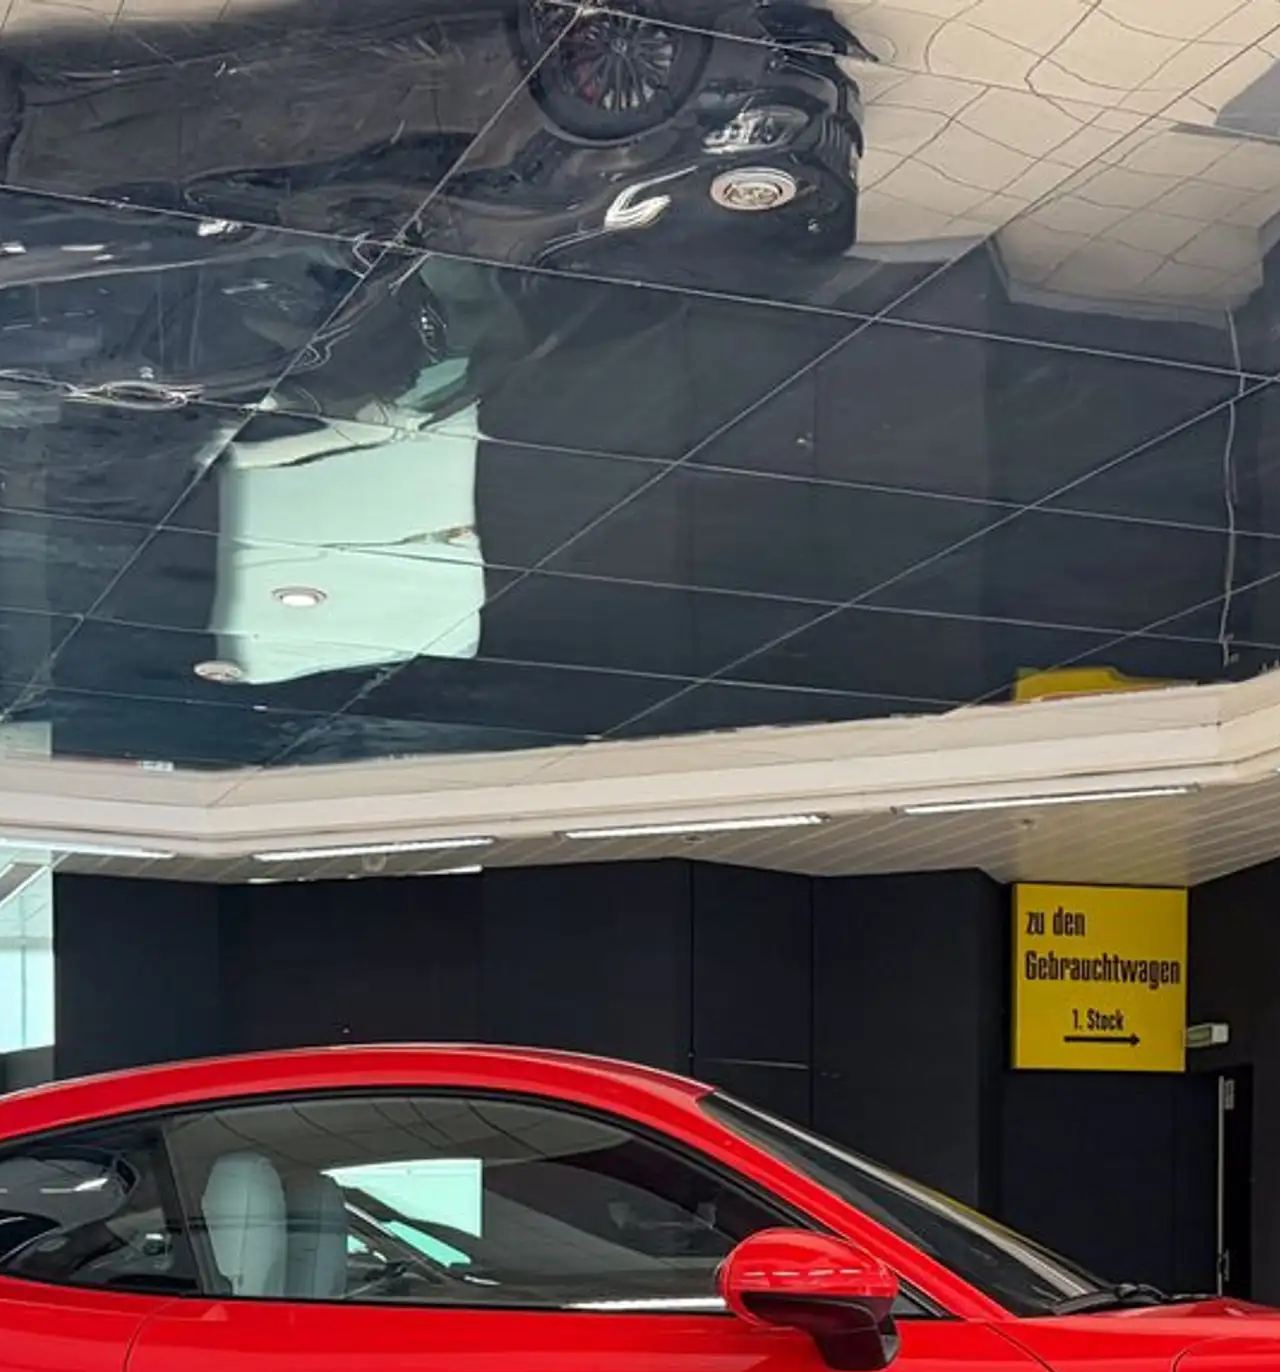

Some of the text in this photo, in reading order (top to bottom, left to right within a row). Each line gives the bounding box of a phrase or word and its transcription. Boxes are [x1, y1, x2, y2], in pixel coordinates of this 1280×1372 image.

[1026, 906, 1085, 937] zu den
[1026, 951, 1181, 990] Gebrauchtwagen
[1072, 1008, 1124, 1031] 1. Stock
